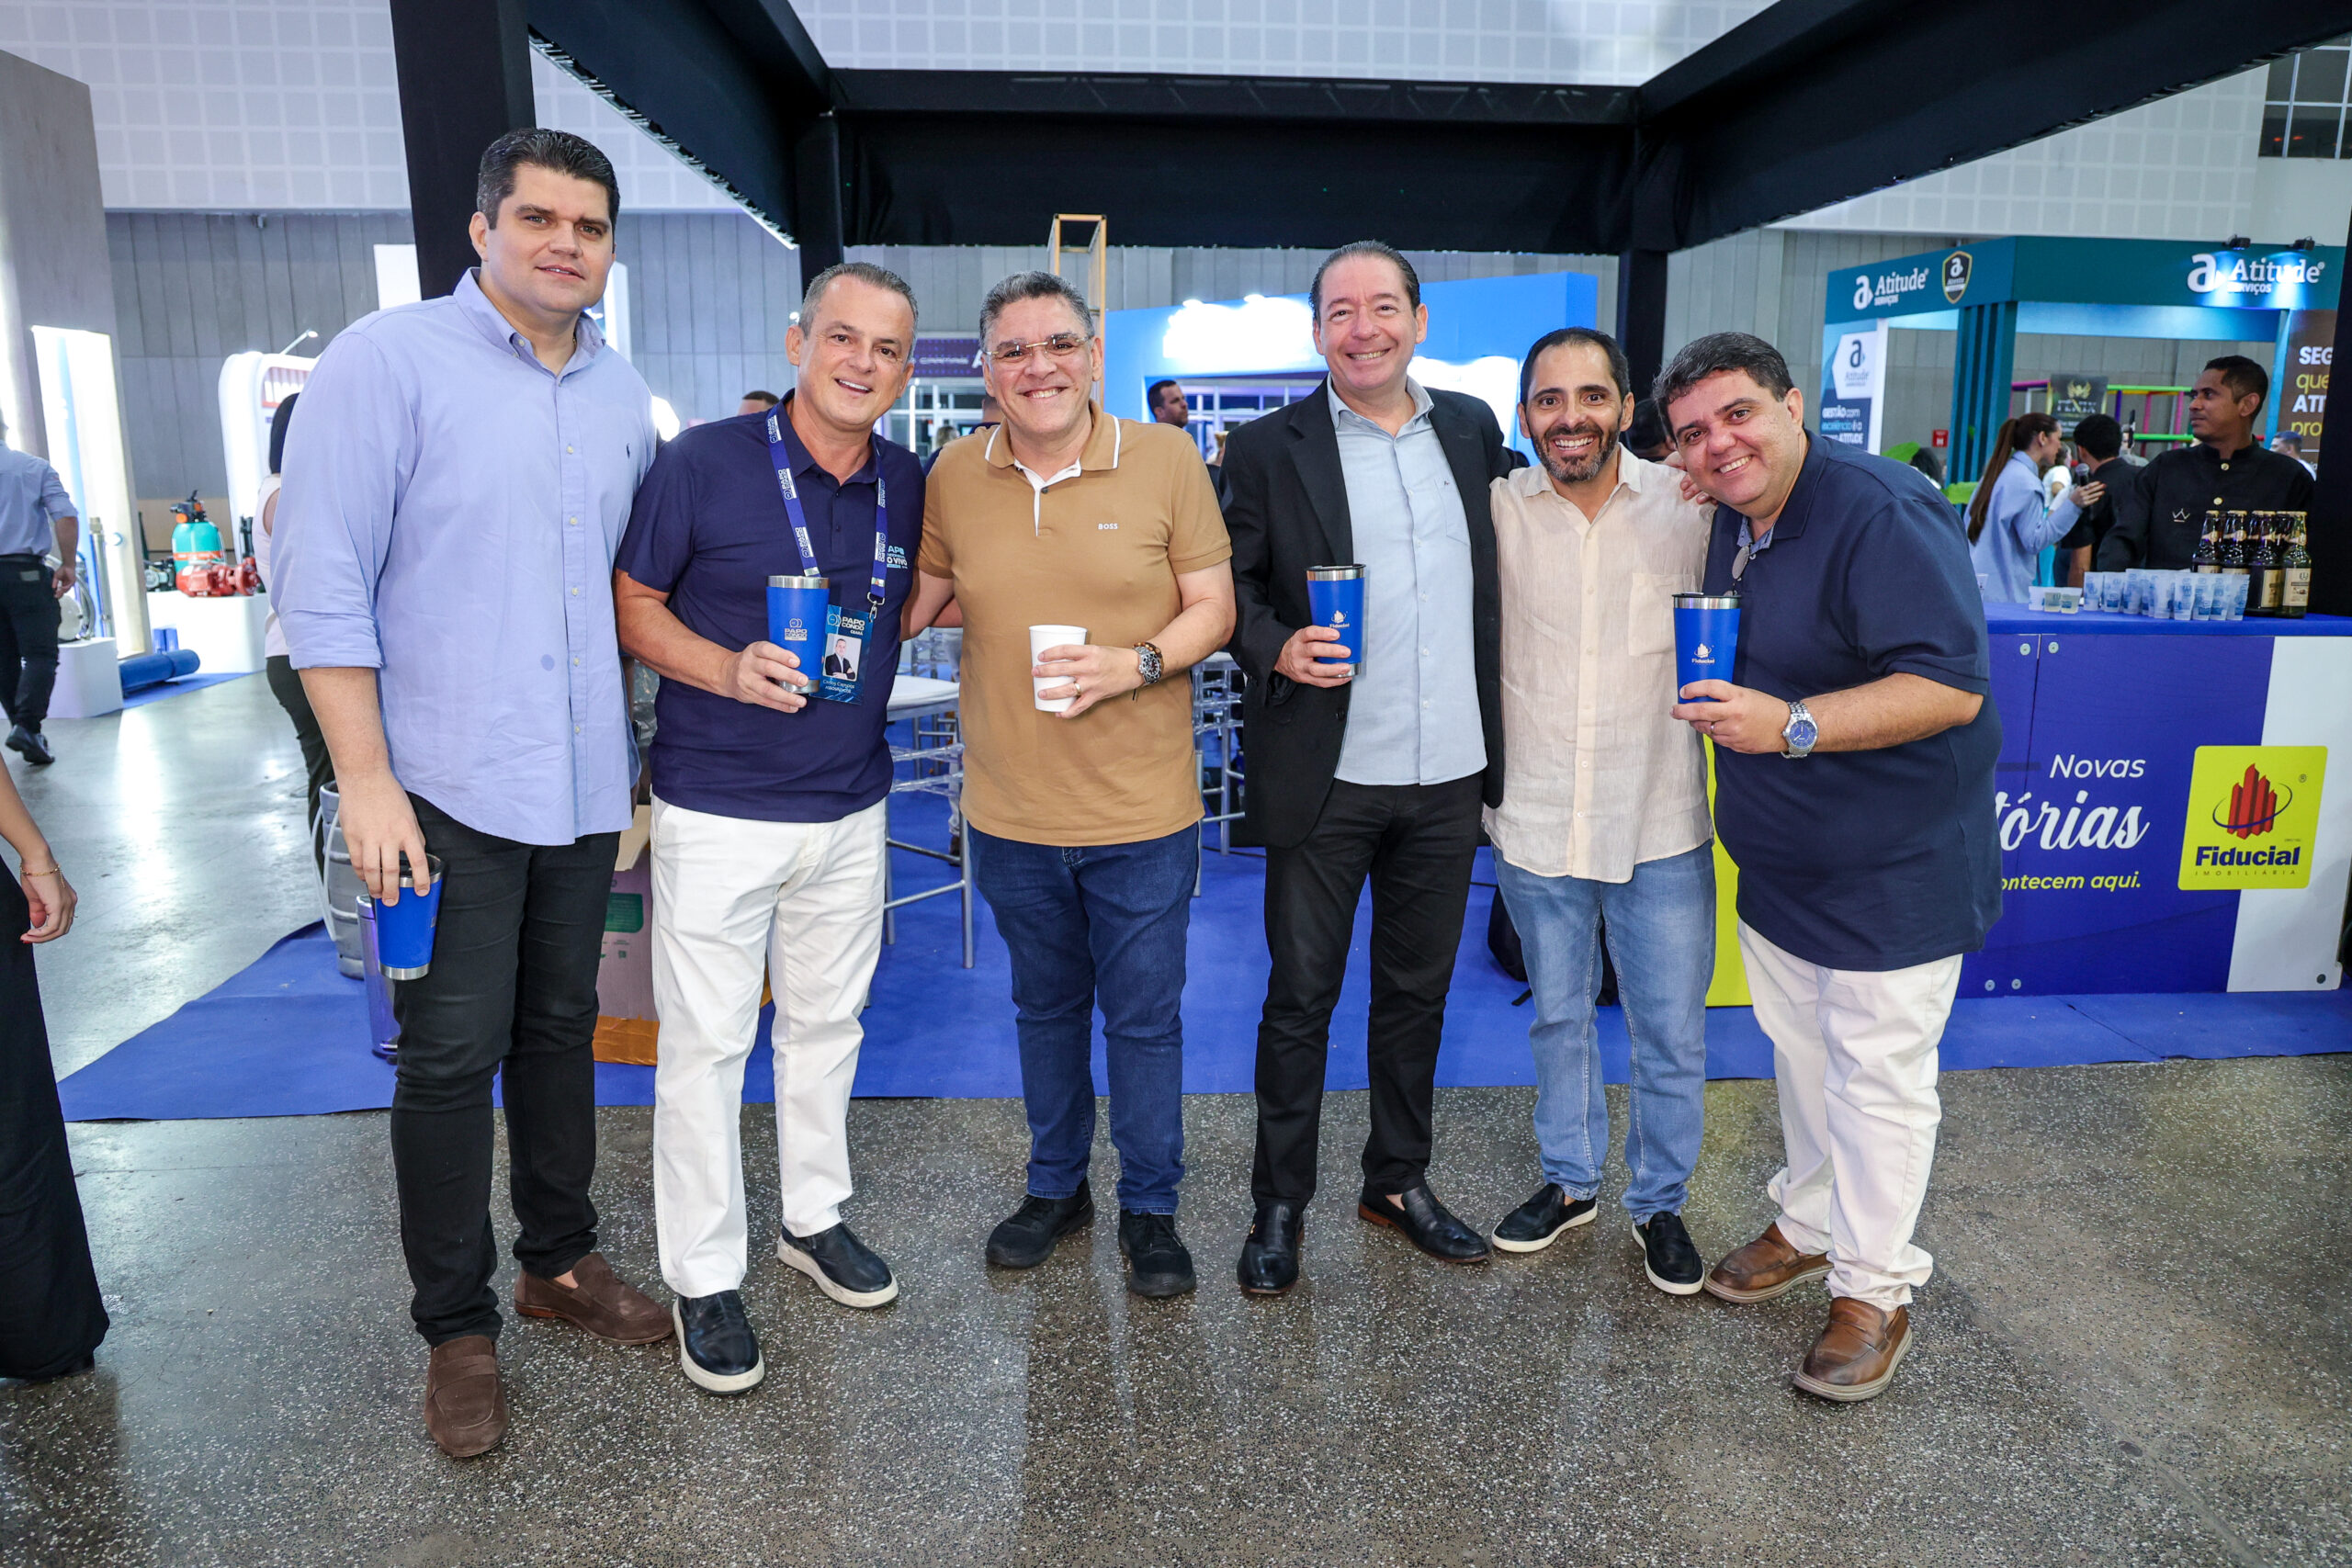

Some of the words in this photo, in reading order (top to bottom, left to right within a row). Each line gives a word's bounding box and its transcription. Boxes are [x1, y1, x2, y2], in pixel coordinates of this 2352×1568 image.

[2227, 257, 2321, 284] Atitude
[1874, 267, 1928, 296] Atitude
[2227, 282, 2272, 295] RVIÇOS
[2291, 394, 2327, 413] ATI
[841, 622, 865, 631] CONDO
[842, 616, 865, 626] PAPO
[2049, 754, 2146, 779] Novas
[2195, 845, 2301, 866] Fiducial
[2090, 871, 2141, 892] aqui.
